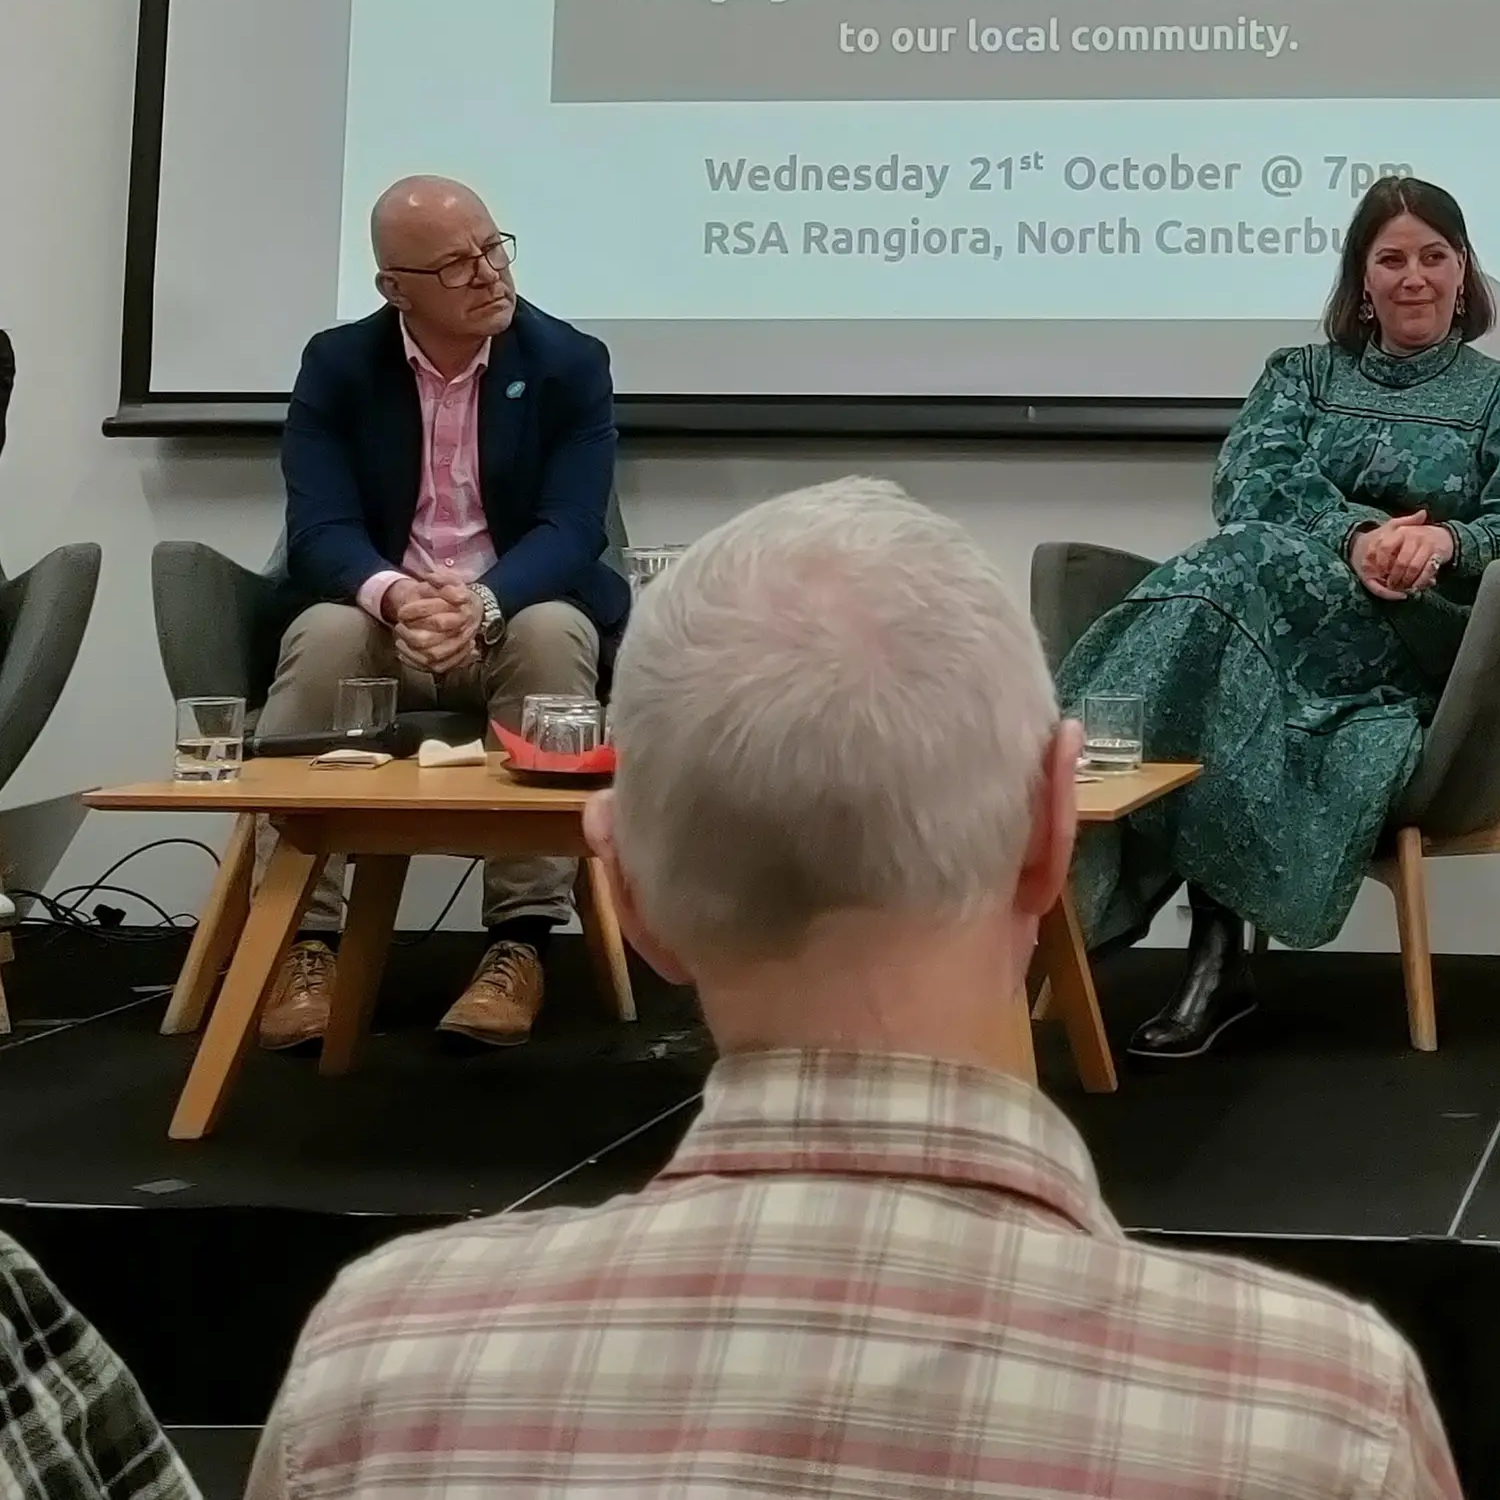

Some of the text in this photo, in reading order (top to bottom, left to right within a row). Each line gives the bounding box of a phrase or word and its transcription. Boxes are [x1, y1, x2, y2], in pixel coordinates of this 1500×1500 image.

[839, 16, 1299, 58] to our local community.
[704, 154, 951, 201] Wednesday
[968, 151, 1045, 192] 21st
[1063, 152, 1243, 192] October
[1261, 154, 1304, 198] @
[702, 215, 1345, 264] RSA Rangiora, North Canterbu
